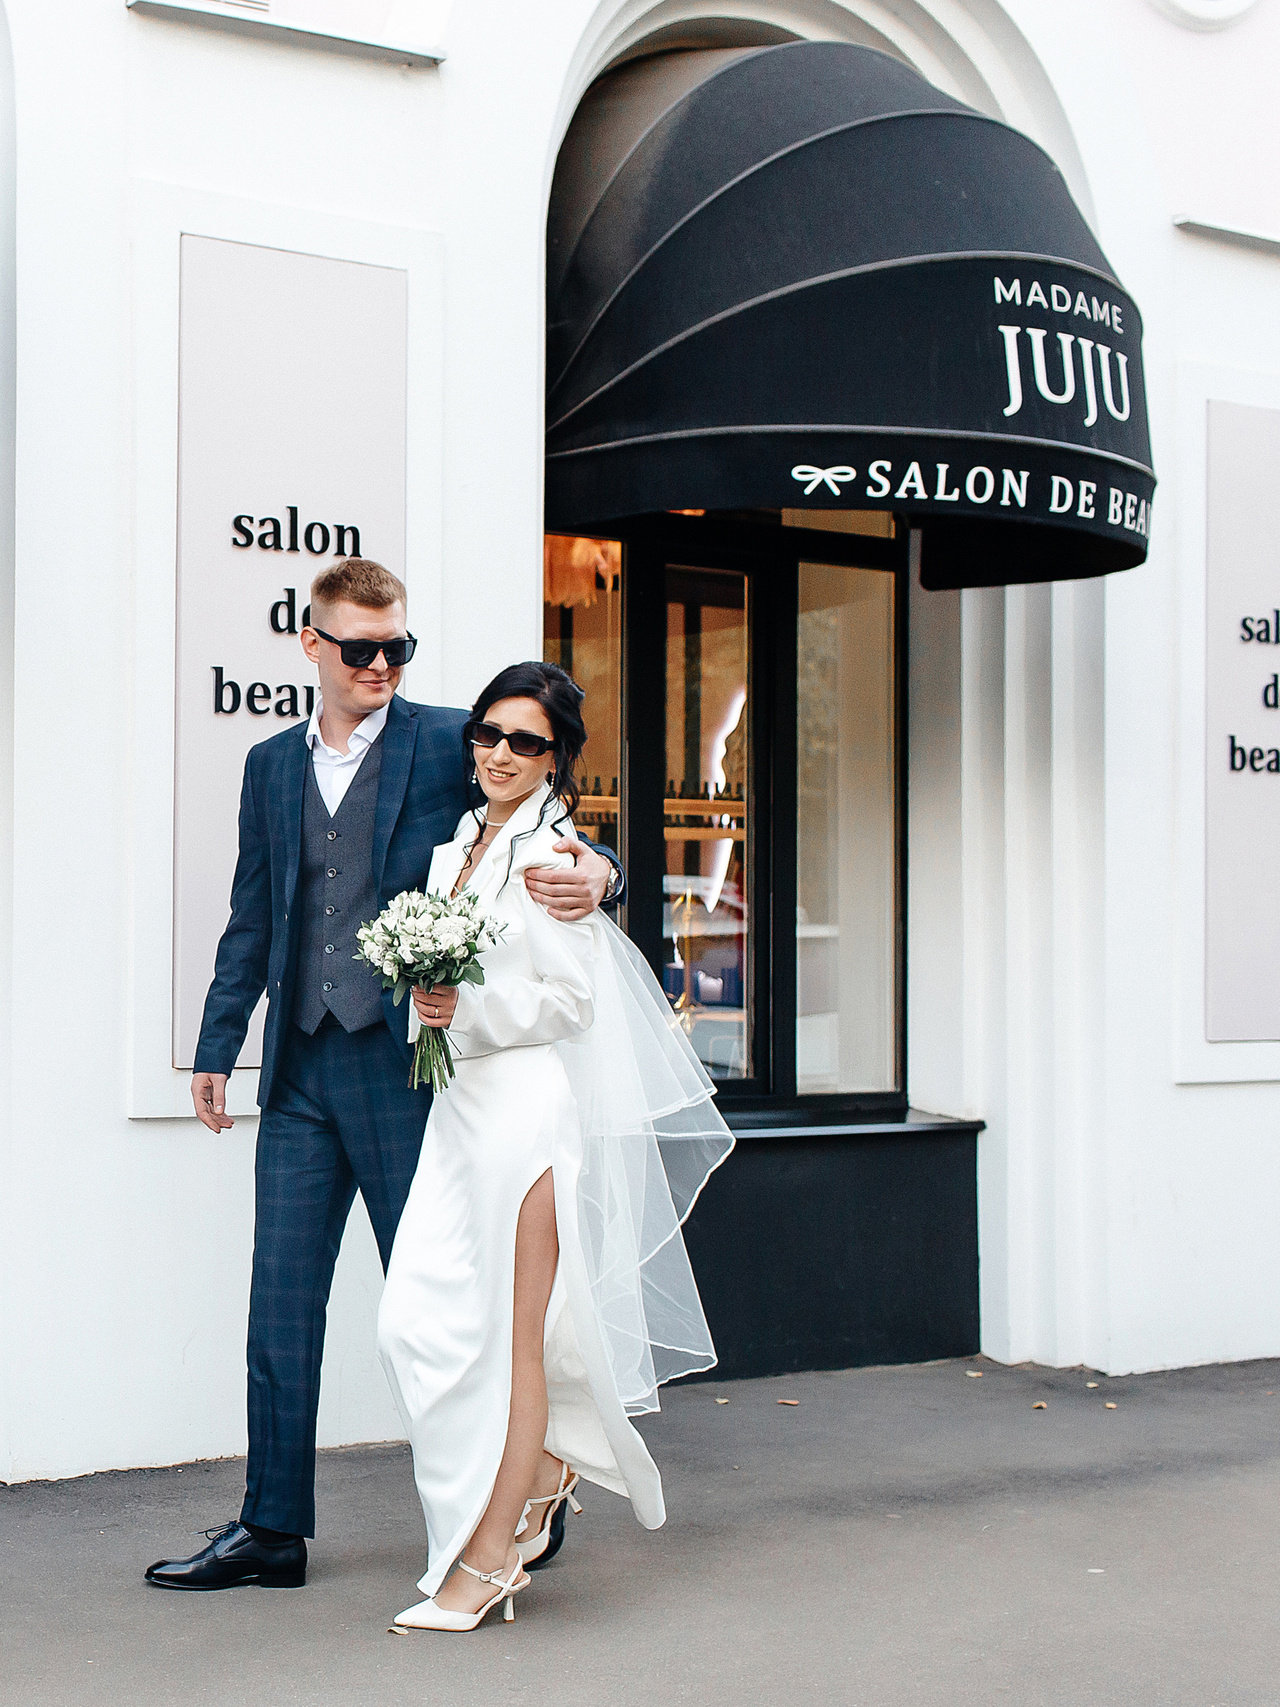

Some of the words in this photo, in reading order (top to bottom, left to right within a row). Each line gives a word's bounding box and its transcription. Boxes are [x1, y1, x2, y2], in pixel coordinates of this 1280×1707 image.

[993, 276, 1124, 335] MADAME
[997, 324, 1131, 428] JUJU
[866, 460, 1030, 508] SALON
[1049, 475, 1097, 519] DE
[232, 505, 363, 559] salon
